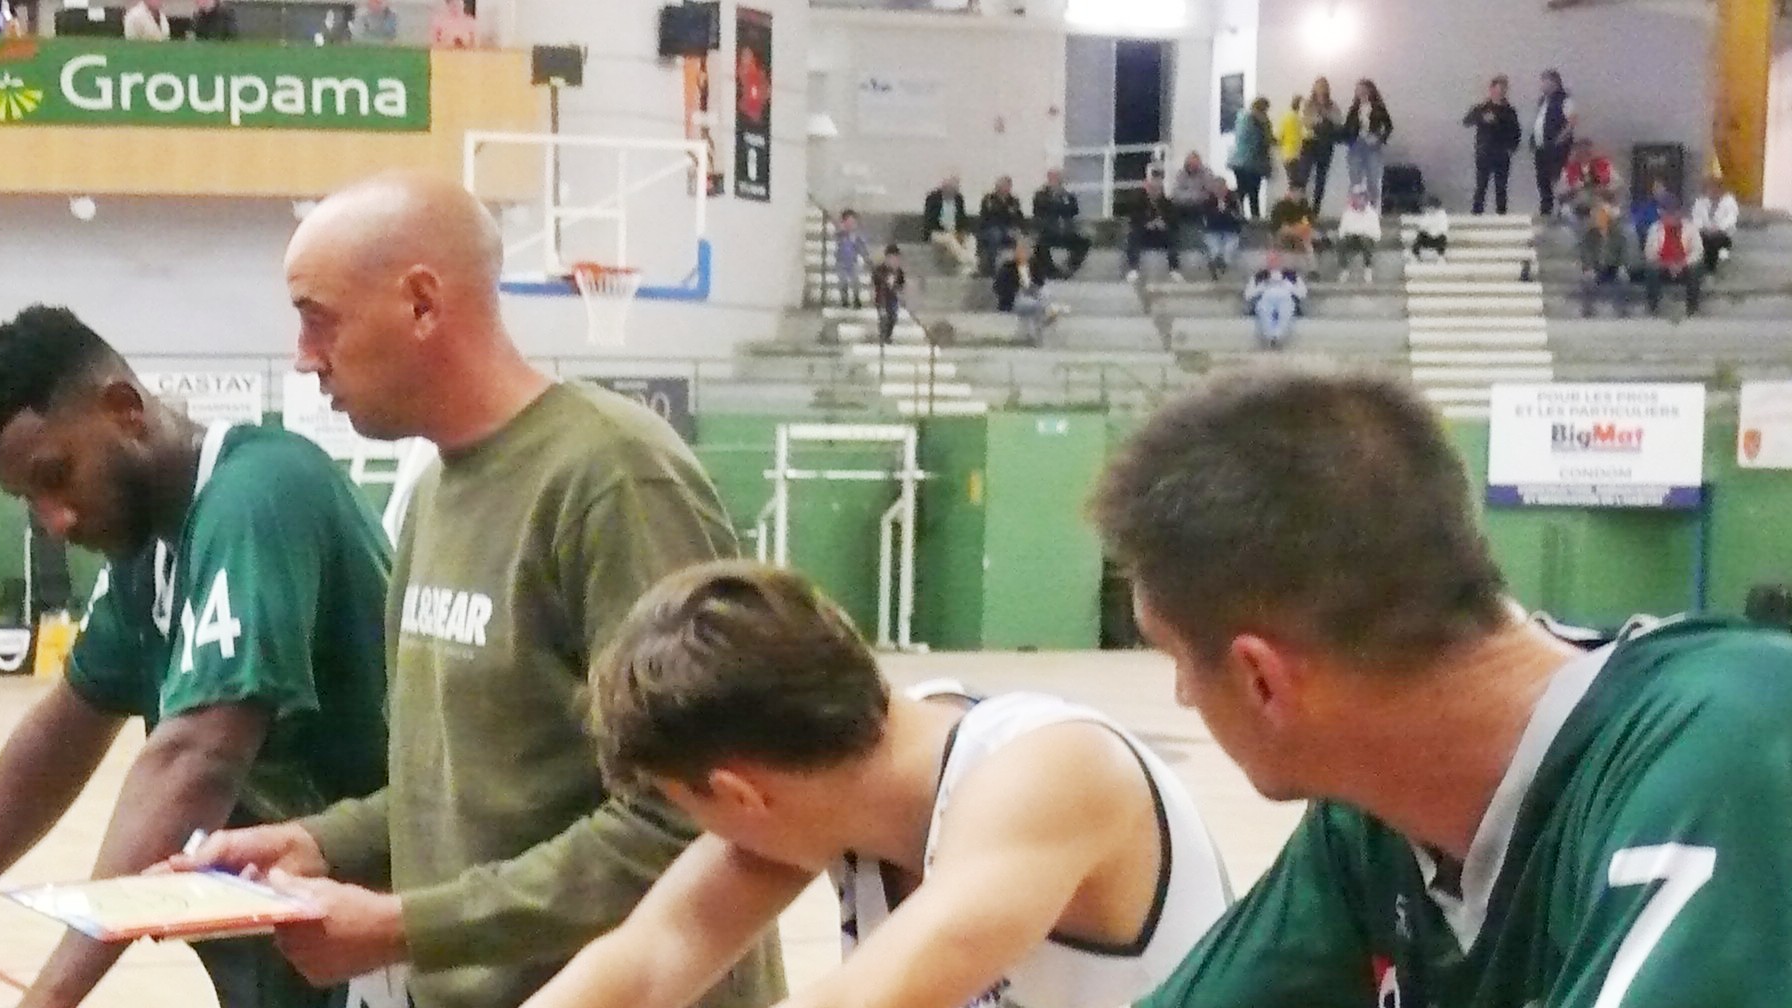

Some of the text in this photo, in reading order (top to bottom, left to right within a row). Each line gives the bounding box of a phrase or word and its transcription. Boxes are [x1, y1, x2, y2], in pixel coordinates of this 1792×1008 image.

[59, 54, 407, 126] Groupama
[158, 375, 253, 394] CASTAY
[1536, 391, 1659, 403] POUR LES PROS
[1515, 406, 1680, 418] ET LES PARTICULIERS
[1551, 422, 1644, 448] BigMat
[1558, 466, 1633, 479] CONDOM
[180, 566, 242, 674] 14
